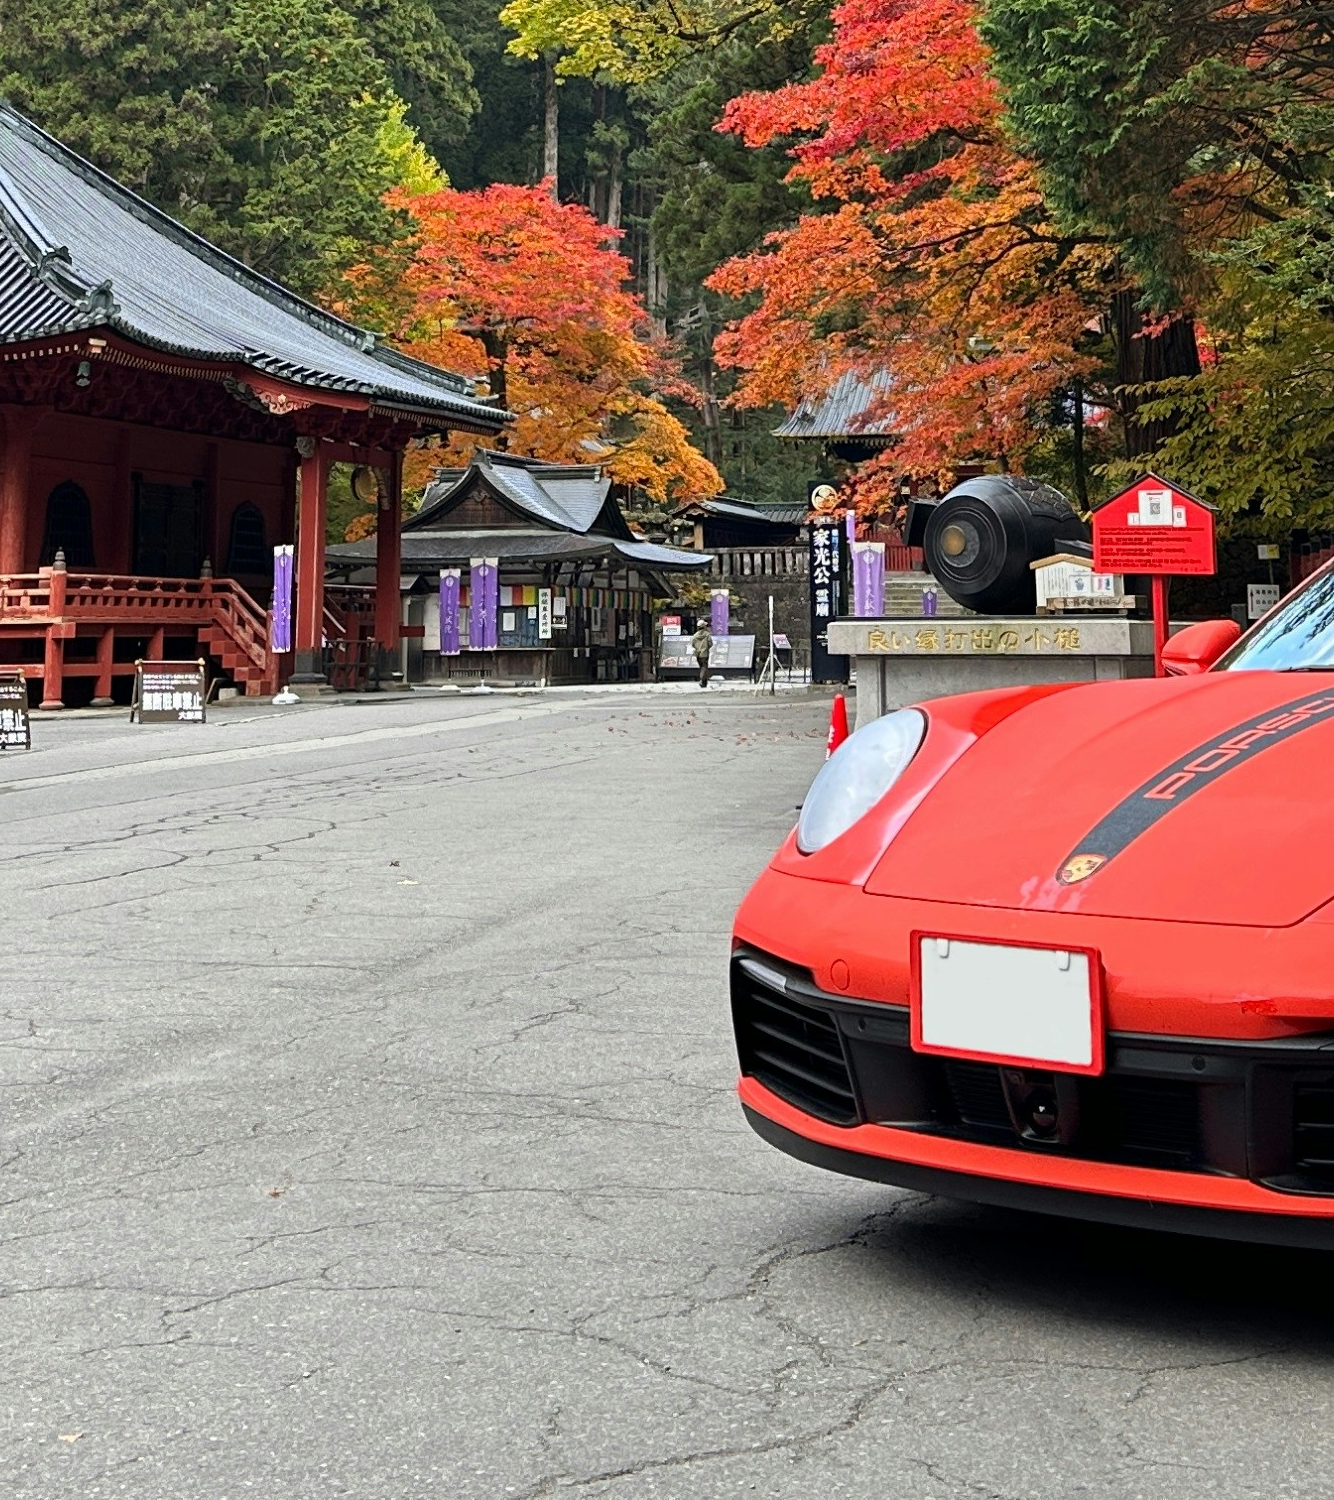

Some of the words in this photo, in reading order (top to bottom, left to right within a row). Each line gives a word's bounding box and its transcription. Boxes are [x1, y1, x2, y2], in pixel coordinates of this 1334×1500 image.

[867, 625, 1081, 651] 良い縁打出の小槌
